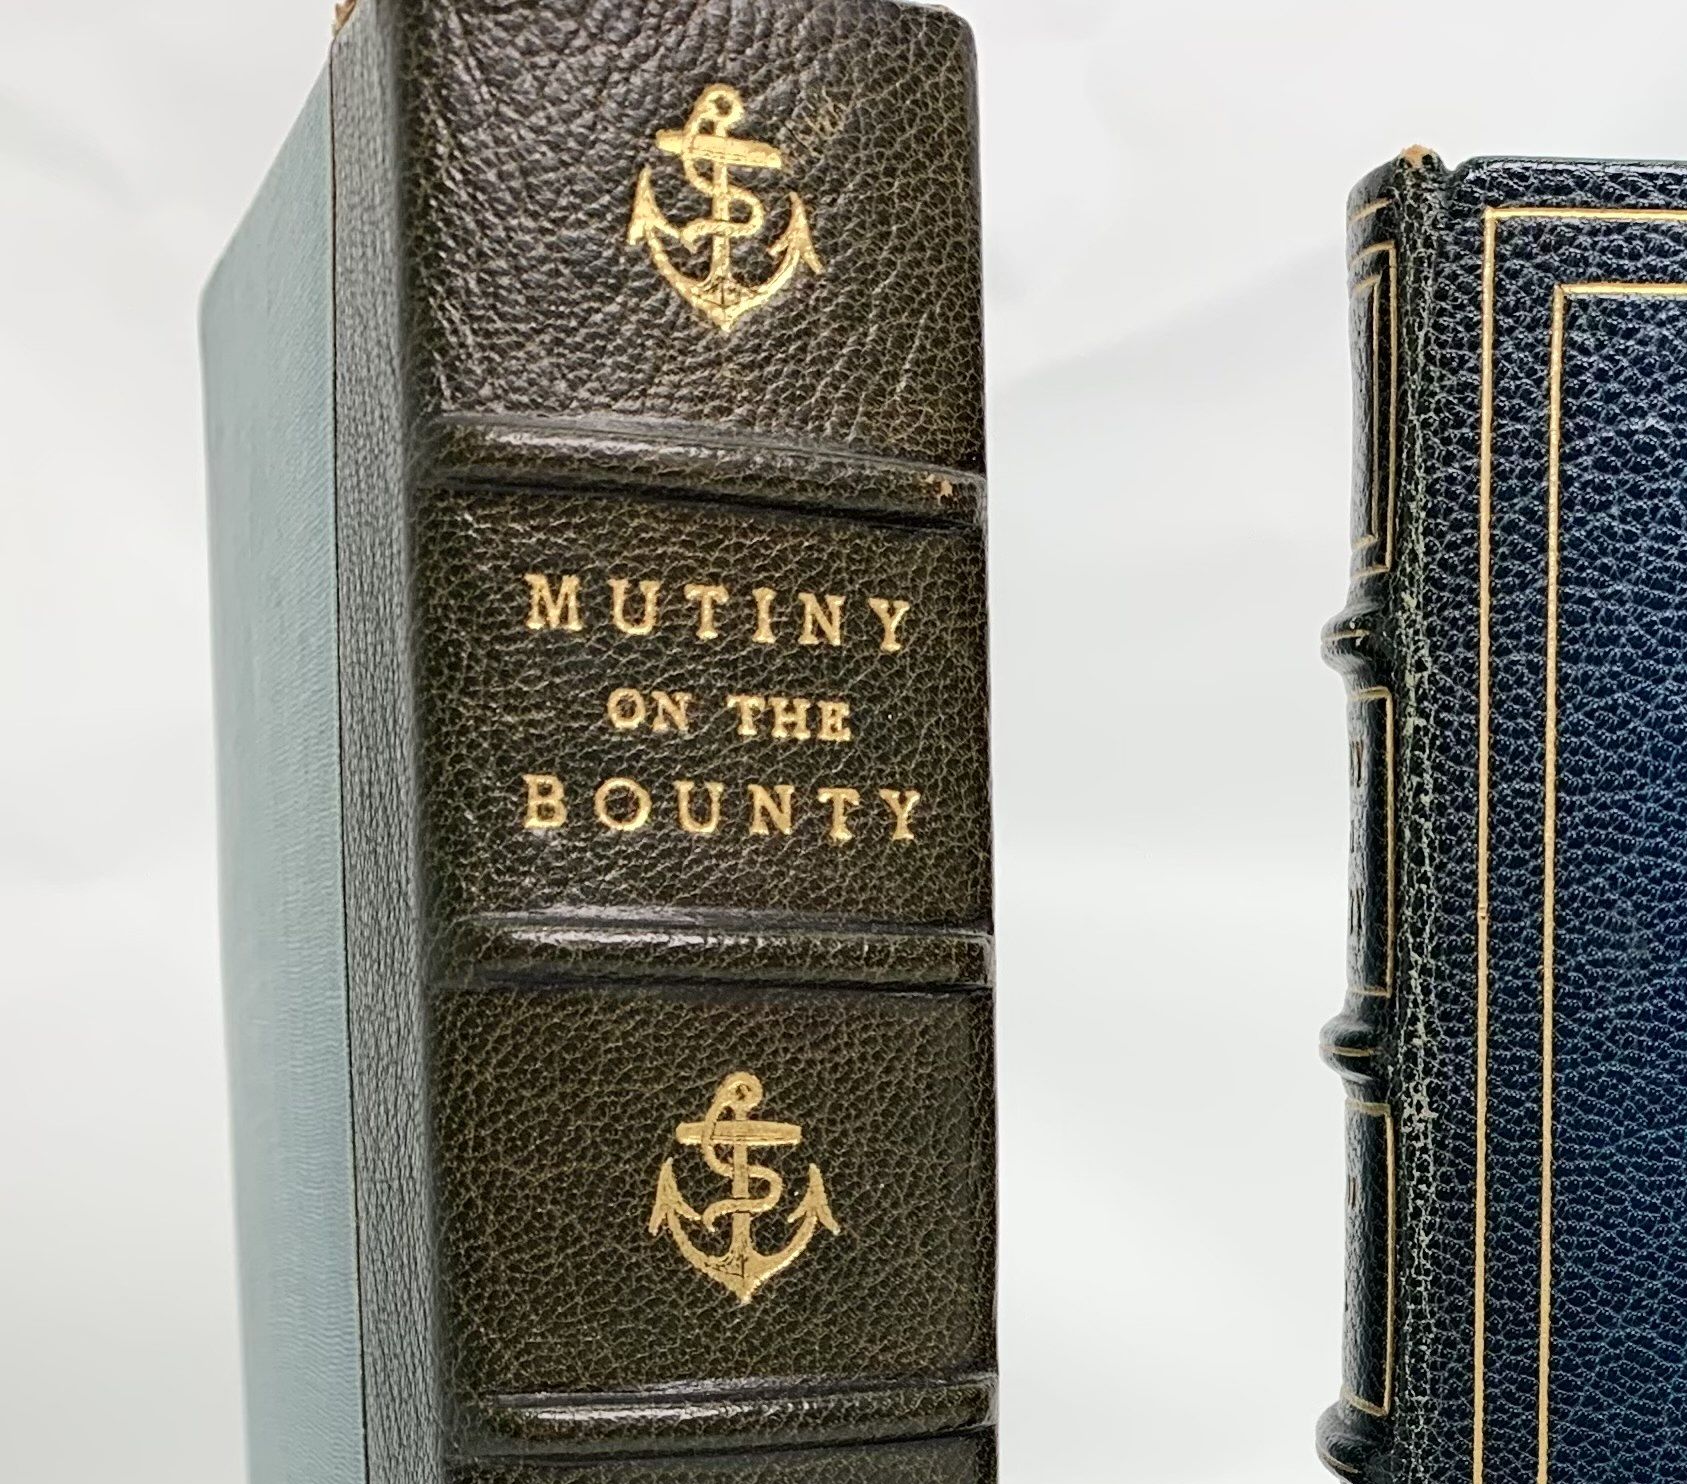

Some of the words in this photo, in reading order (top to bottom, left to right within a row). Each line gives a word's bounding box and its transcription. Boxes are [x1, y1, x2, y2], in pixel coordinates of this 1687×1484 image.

[523, 573, 911, 652] MUTINY
[606, 686, 693, 733] ON
[726, 693, 852, 742] THE
[522, 773, 921, 842] BOUNTY
